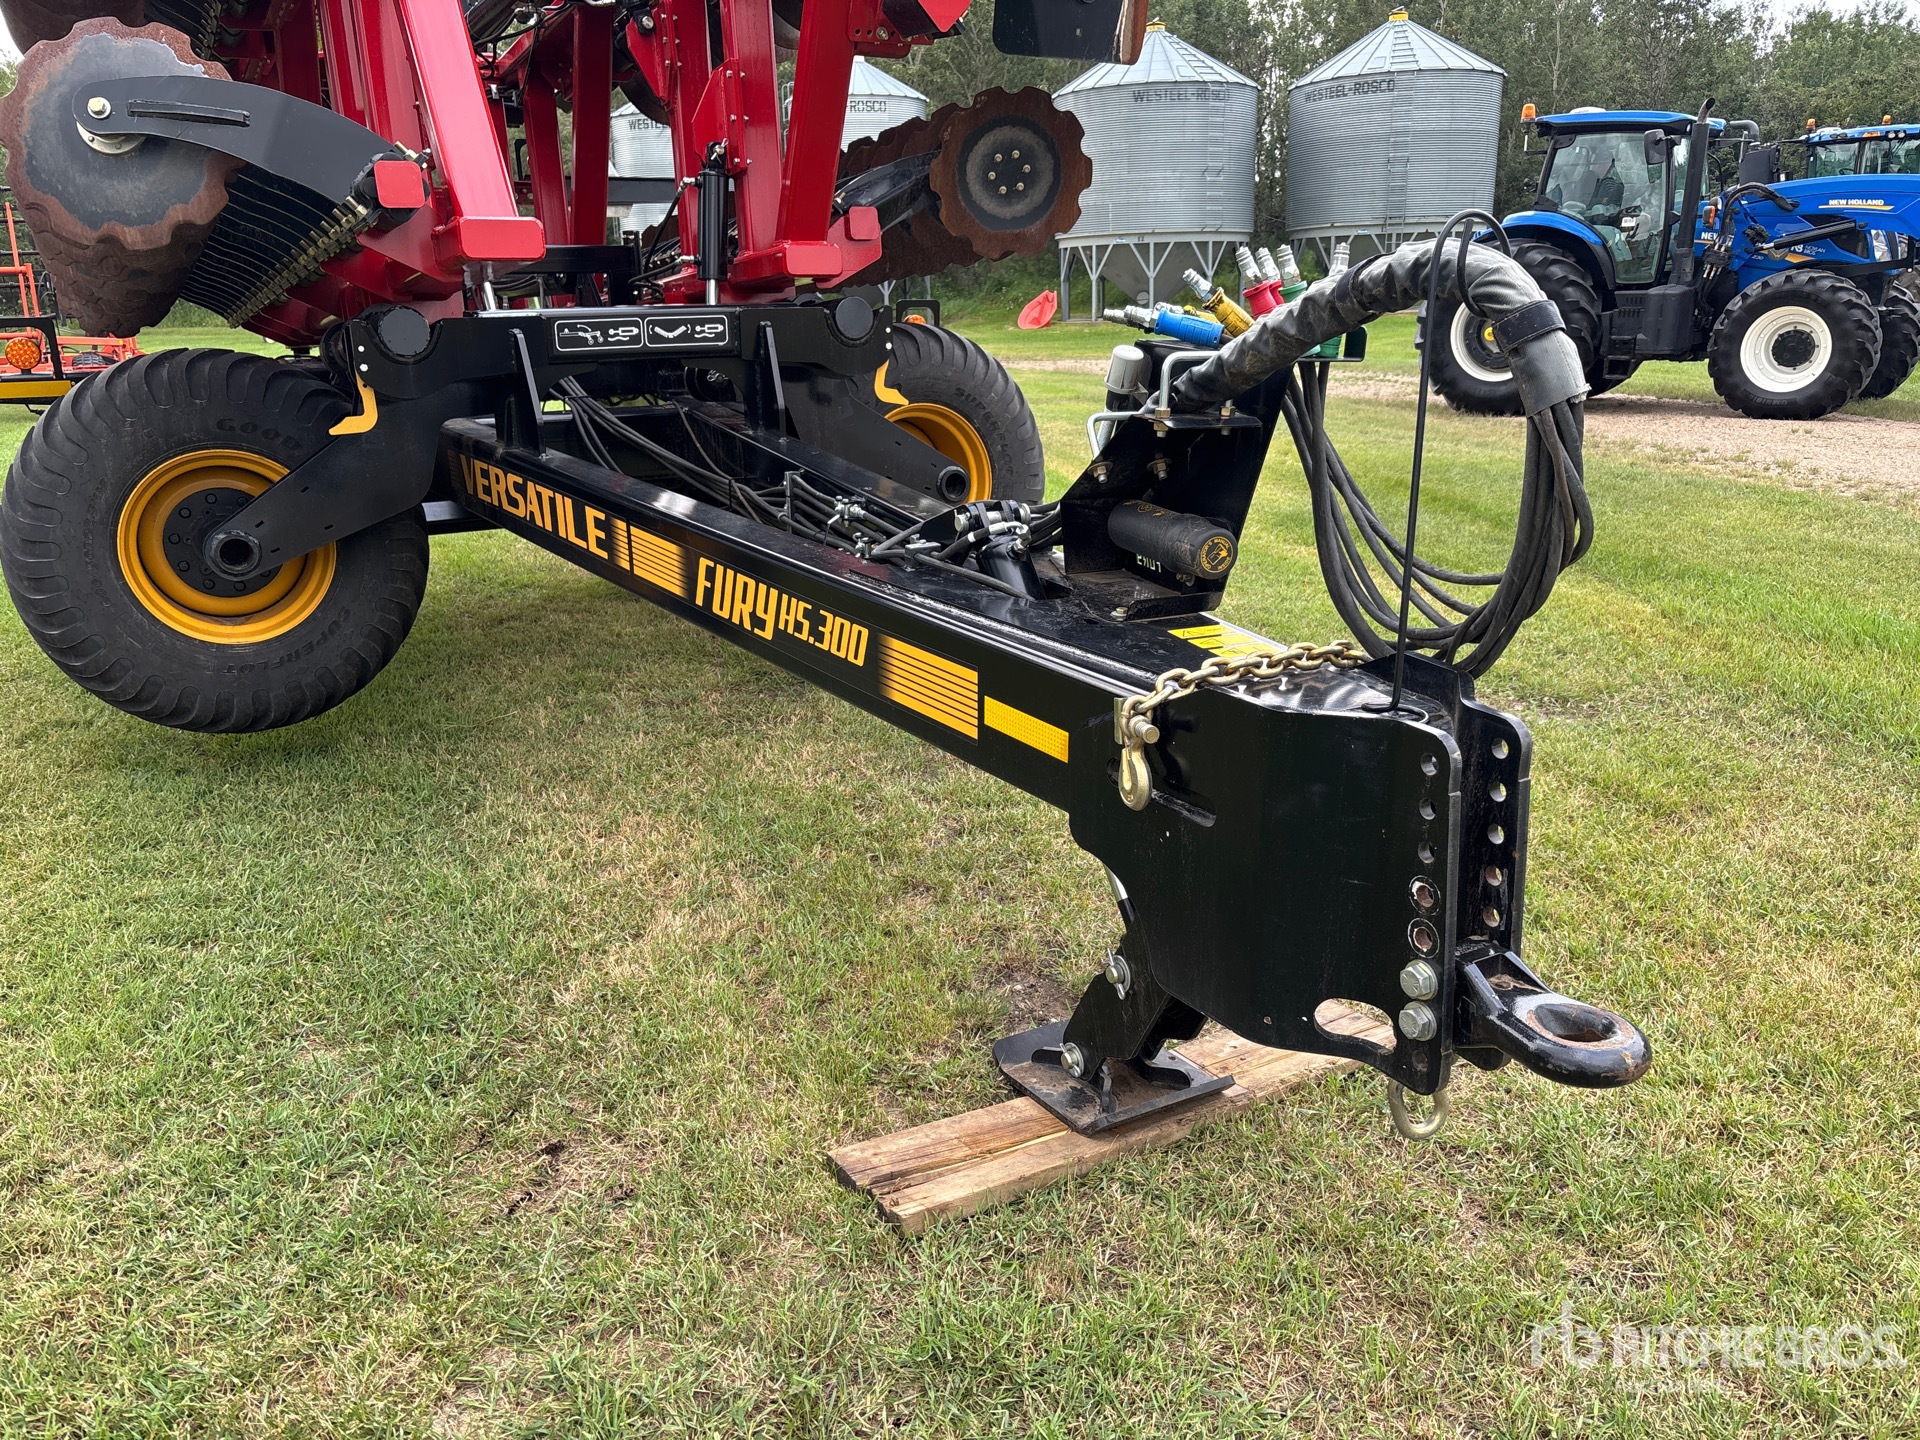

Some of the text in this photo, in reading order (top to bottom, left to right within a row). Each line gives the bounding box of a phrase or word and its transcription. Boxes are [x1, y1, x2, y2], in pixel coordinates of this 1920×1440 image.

[1304, 80, 1395, 102] WESTEEL-ROSCO
[460, 454, 609, 560] VERSATILE
[222, 607, 352, 676] SUPERFLOT
[778, 593, 869, 667] HS.300
